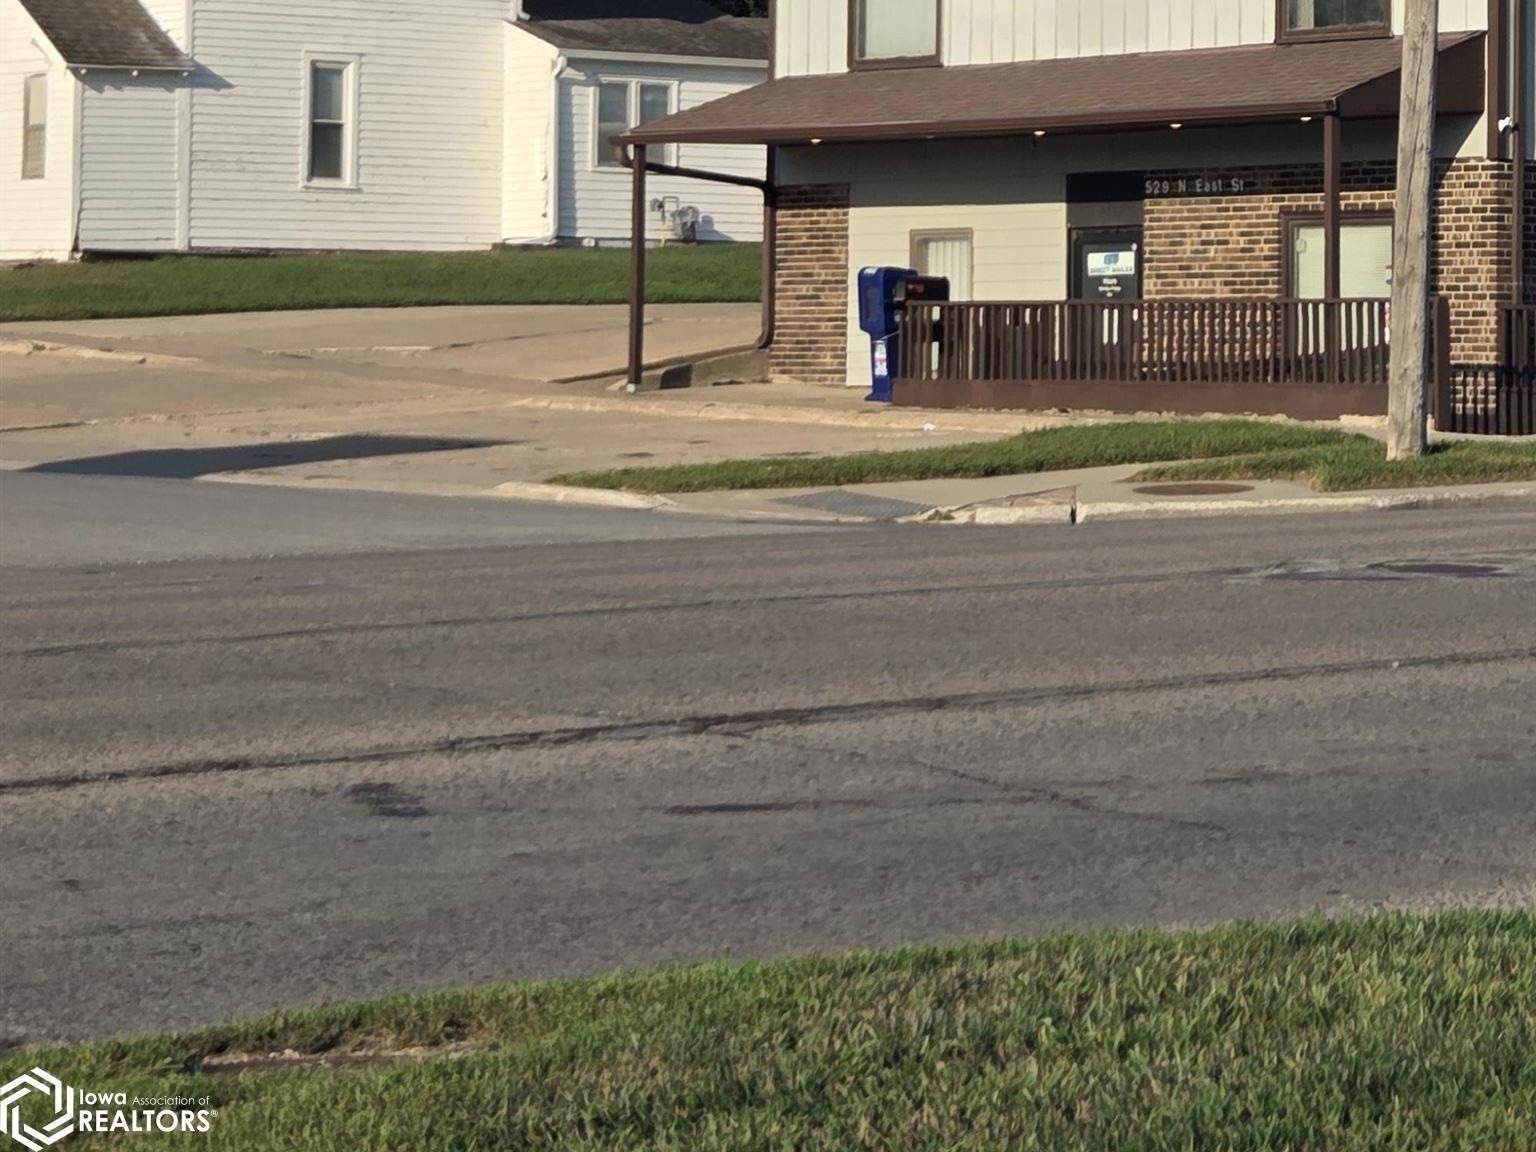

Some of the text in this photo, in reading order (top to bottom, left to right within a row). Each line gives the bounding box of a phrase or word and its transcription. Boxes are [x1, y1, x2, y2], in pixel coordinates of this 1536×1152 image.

[1145, 178, 1244, 194] 529 N East St
